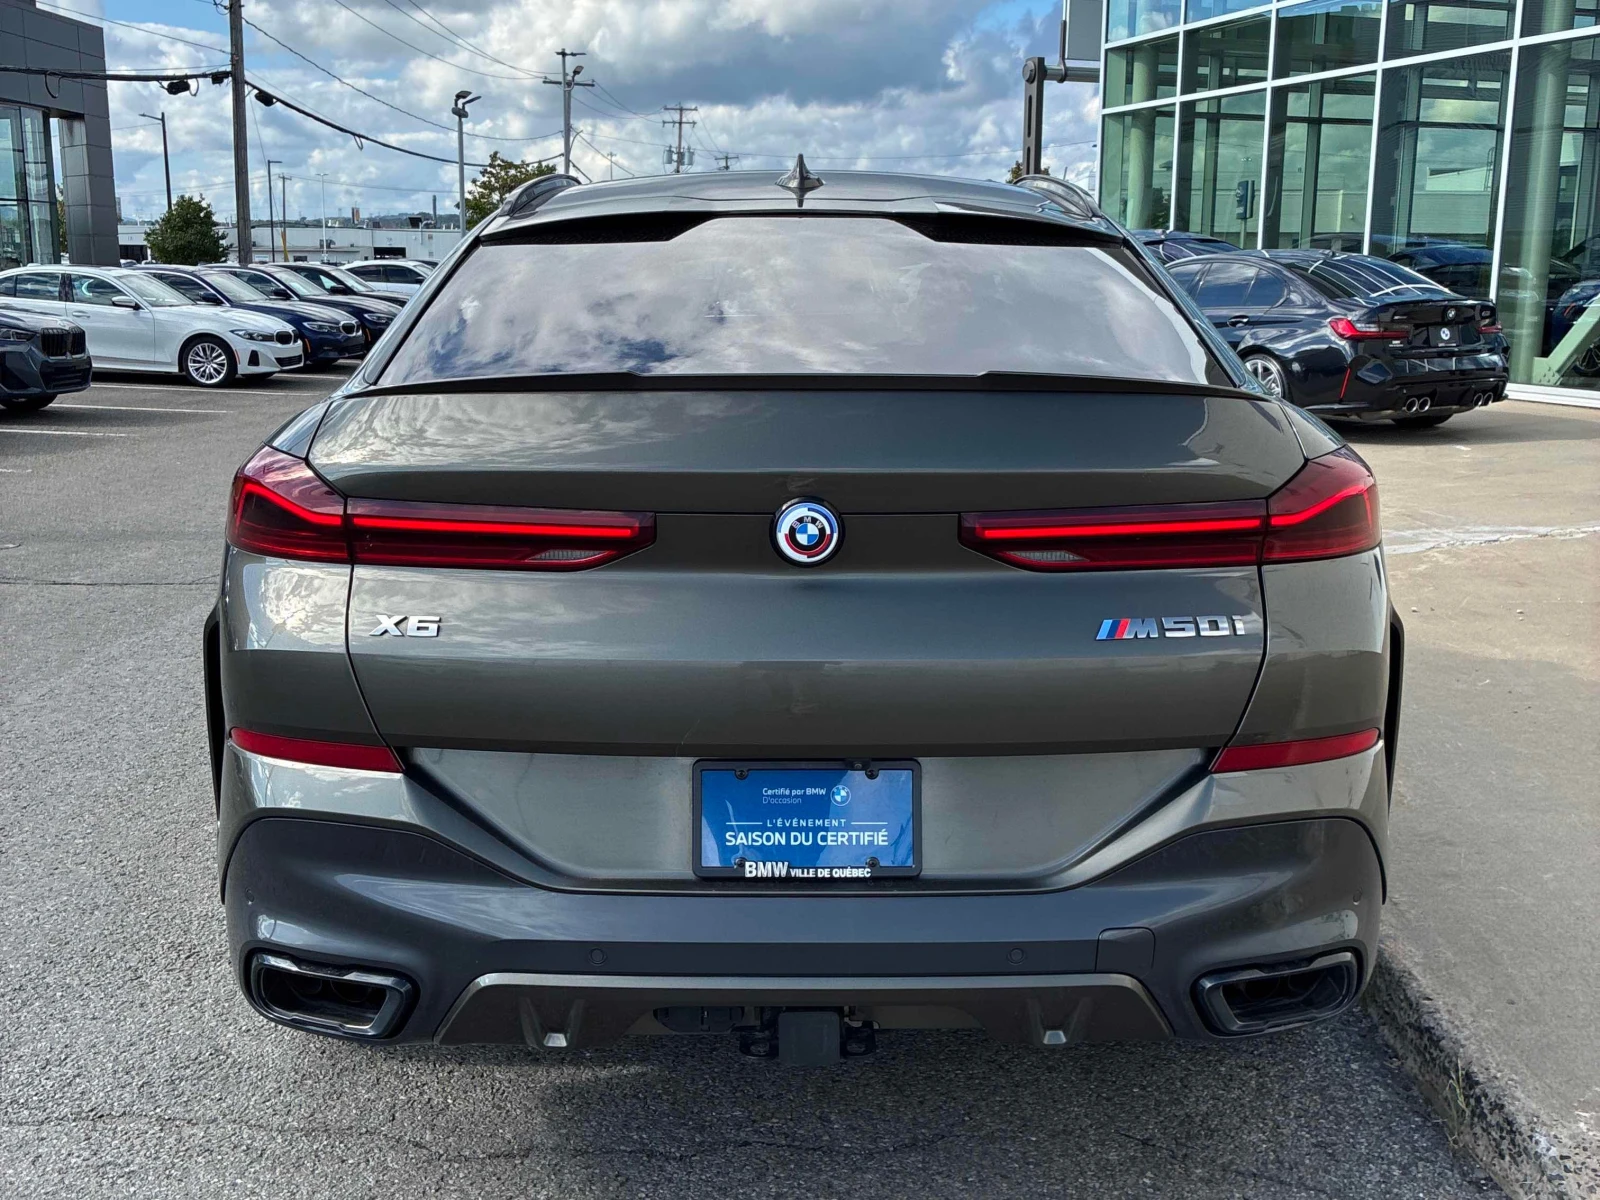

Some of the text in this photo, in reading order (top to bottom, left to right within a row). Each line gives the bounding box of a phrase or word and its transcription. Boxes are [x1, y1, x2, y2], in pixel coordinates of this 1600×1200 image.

[791, 516, 824, 529] BMW
[368, 614, 441, 637] X6
[762, 787, 790, 796] Certifié
[791, 789, 805, 797] par
[805, 787, 827, 796] BMW
[762, 796, 802, 805] D'occasion
[766, 817, 847, 827] L'ÉVÉNEMENT
[725, 829, 889, 846] SAISON DU CERTIFIÉ
[744, 861, 871, 878] BMW VILLE DE QUÉBEC
